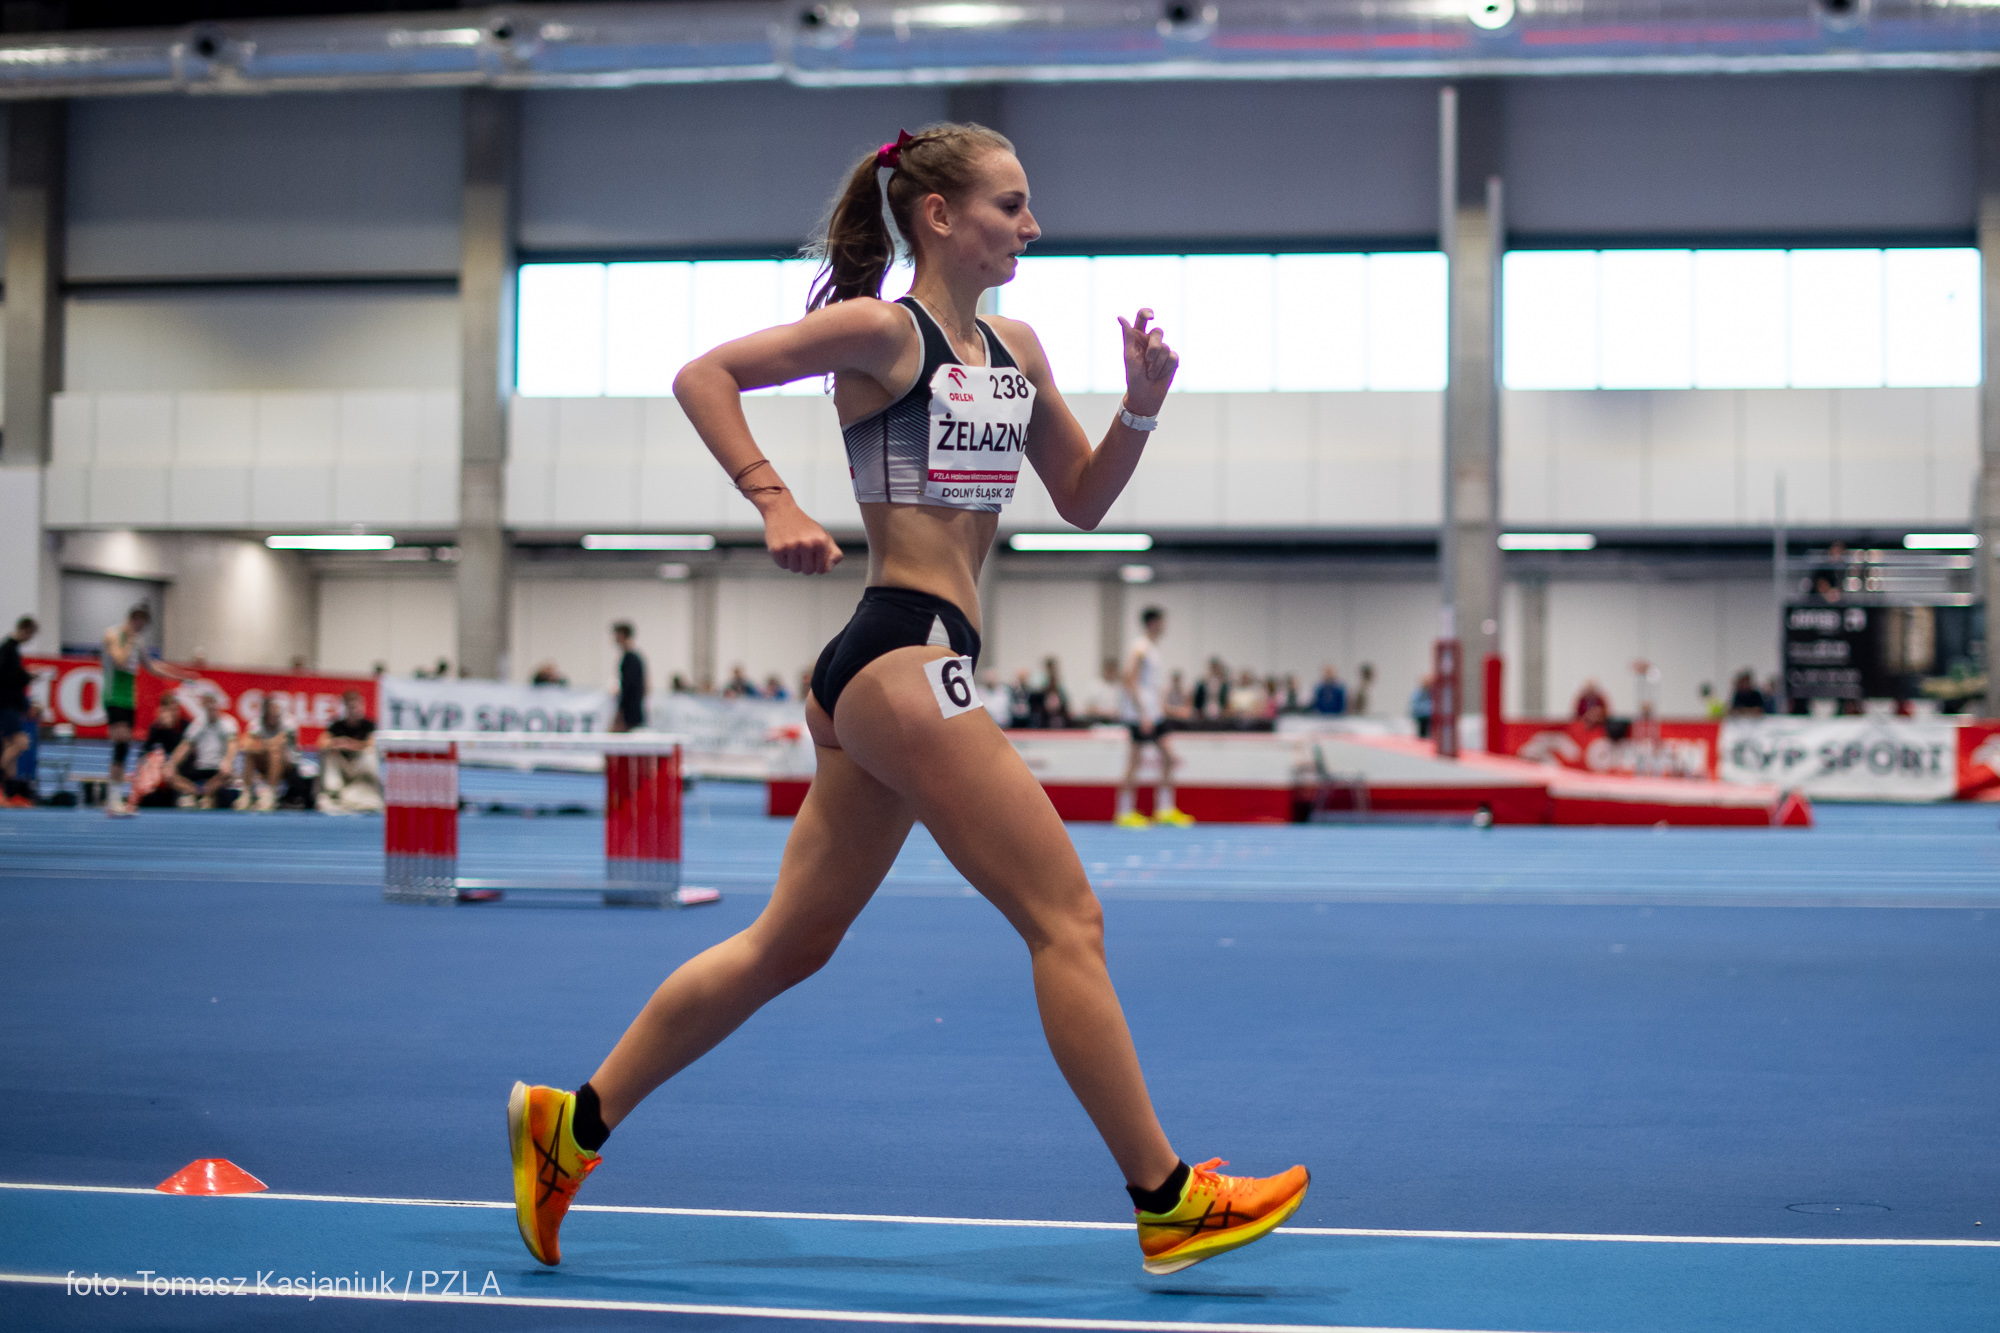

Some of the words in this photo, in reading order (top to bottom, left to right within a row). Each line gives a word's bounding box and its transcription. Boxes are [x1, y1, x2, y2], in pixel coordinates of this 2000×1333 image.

[949, 392, 975, 402] ORLEN
[990, 374, 1029, 399] 238
[933, 472, 950, 480] PZLA
[998, 473, 1014, 481] Polski
[942, 487, 975, 498] DOLNY
[976, 484, 1002, 500] ŚLĄSK
[941, 659, 972, 708] 6
[388, 697, 464, 732] TVP
[473, 702, 598, 734] SPORT
[1817, 740, 1944, 776] SPORT
